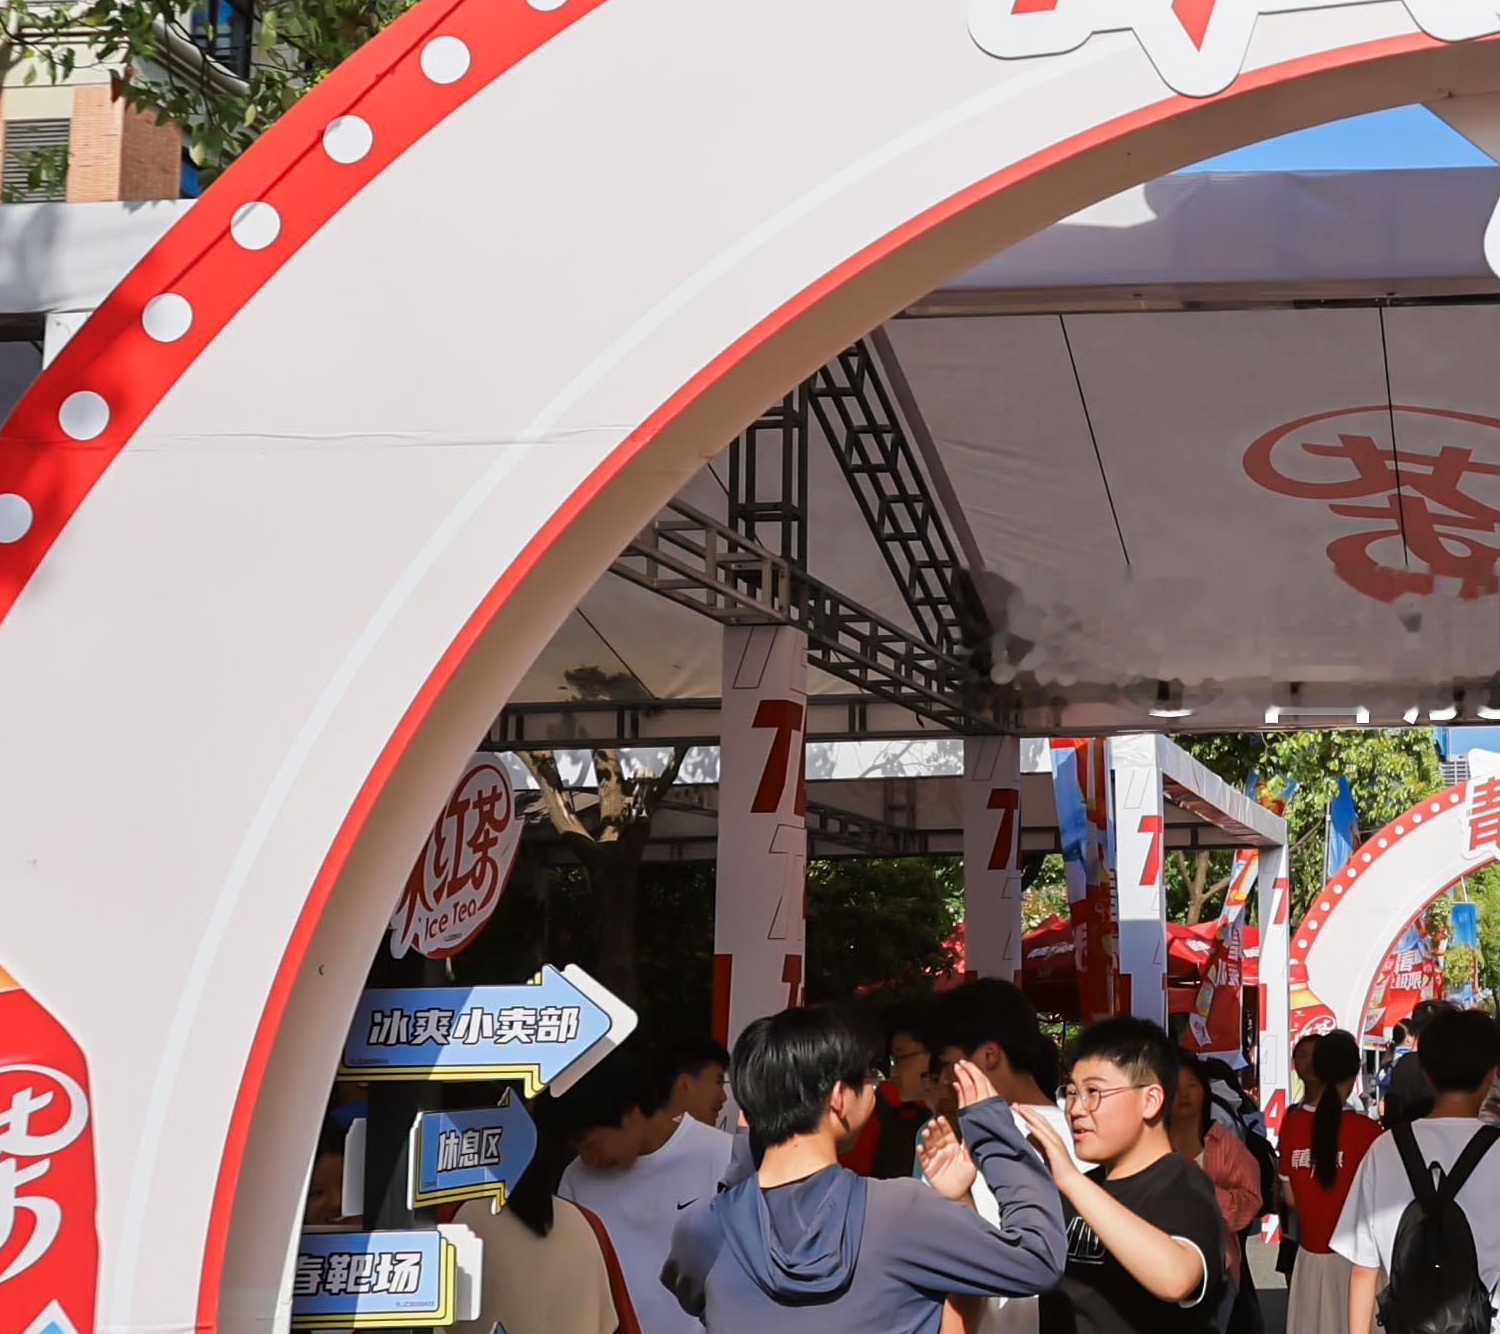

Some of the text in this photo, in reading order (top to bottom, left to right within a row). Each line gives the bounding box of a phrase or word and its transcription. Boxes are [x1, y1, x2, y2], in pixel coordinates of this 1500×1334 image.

[423, 898, 477, 941] Ice Tea
[368, 1006, 580, 1046] 冰爽小卖部
[437, 1125, 502, 1173] 休息区
